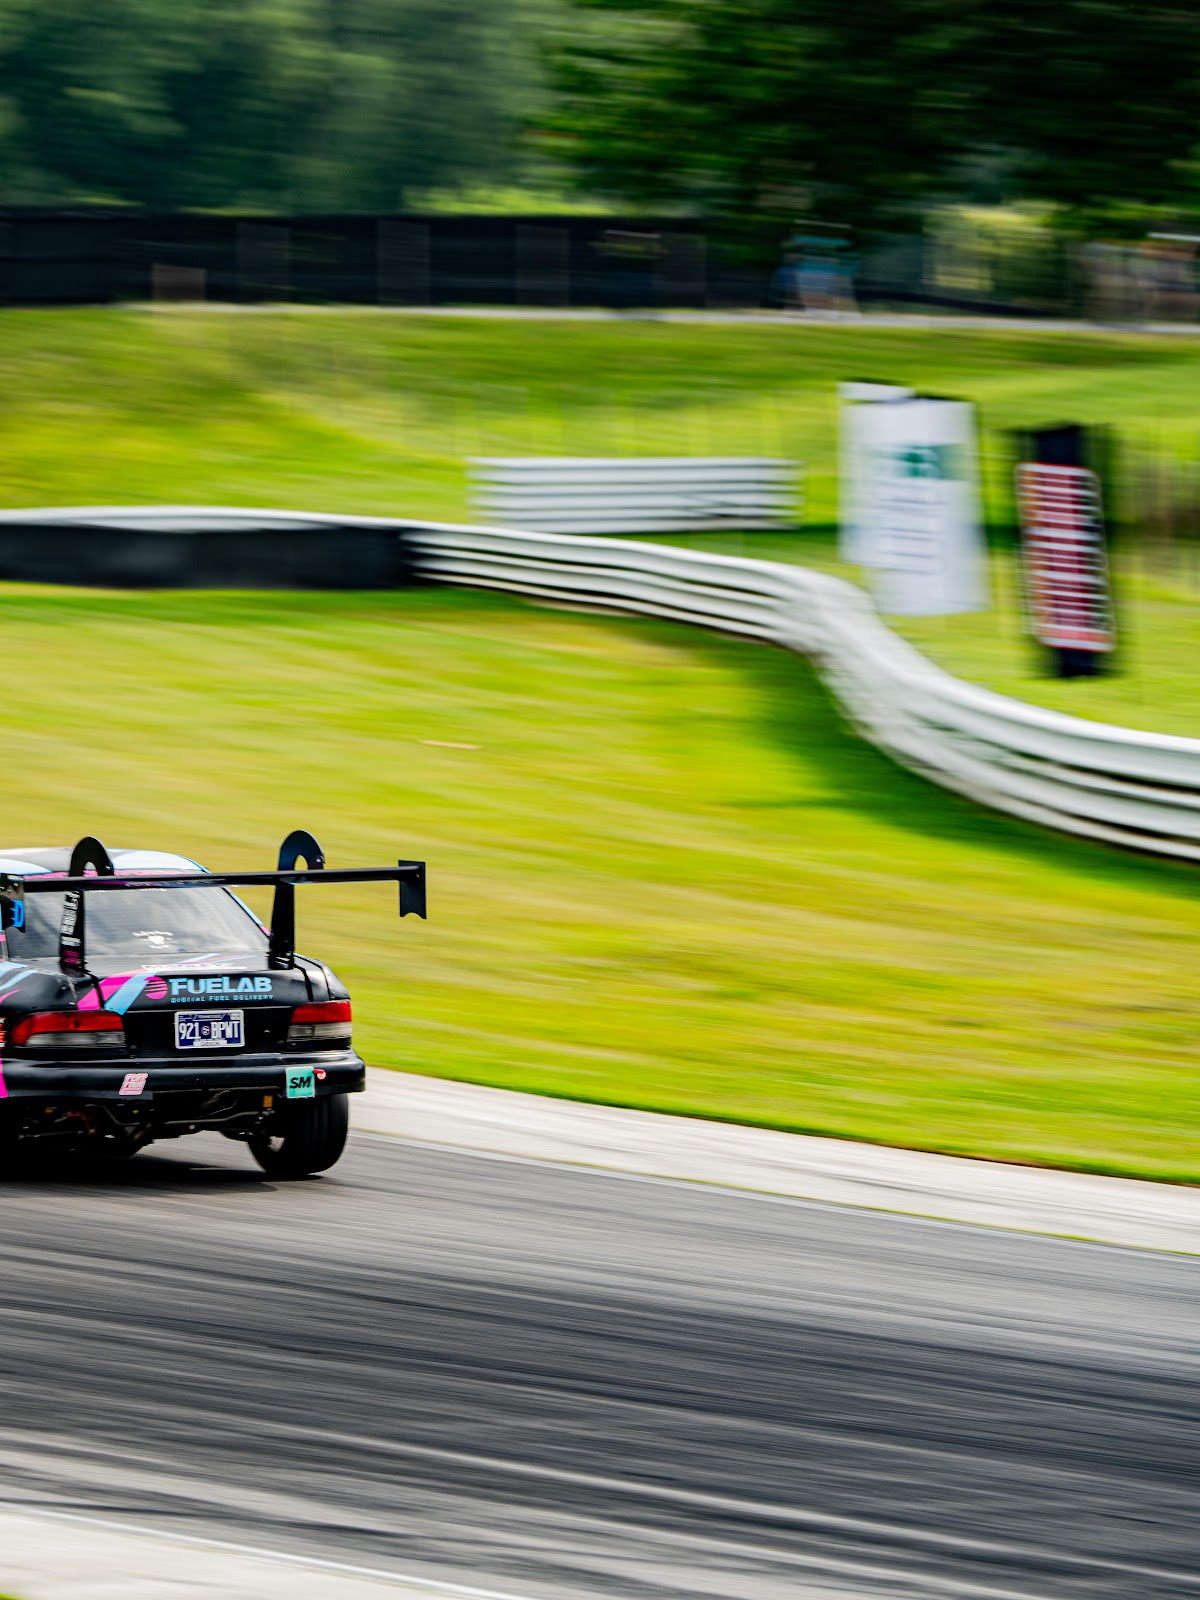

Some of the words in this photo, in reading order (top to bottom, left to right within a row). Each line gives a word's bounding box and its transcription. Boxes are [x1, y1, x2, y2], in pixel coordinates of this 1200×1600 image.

[168, 976, 273, 996] FUELAB
[179, 1022, 202, 1040] 921
[210, 1021, 240, 1039] BPWT
[289, 1076, 312, 1089] SM
